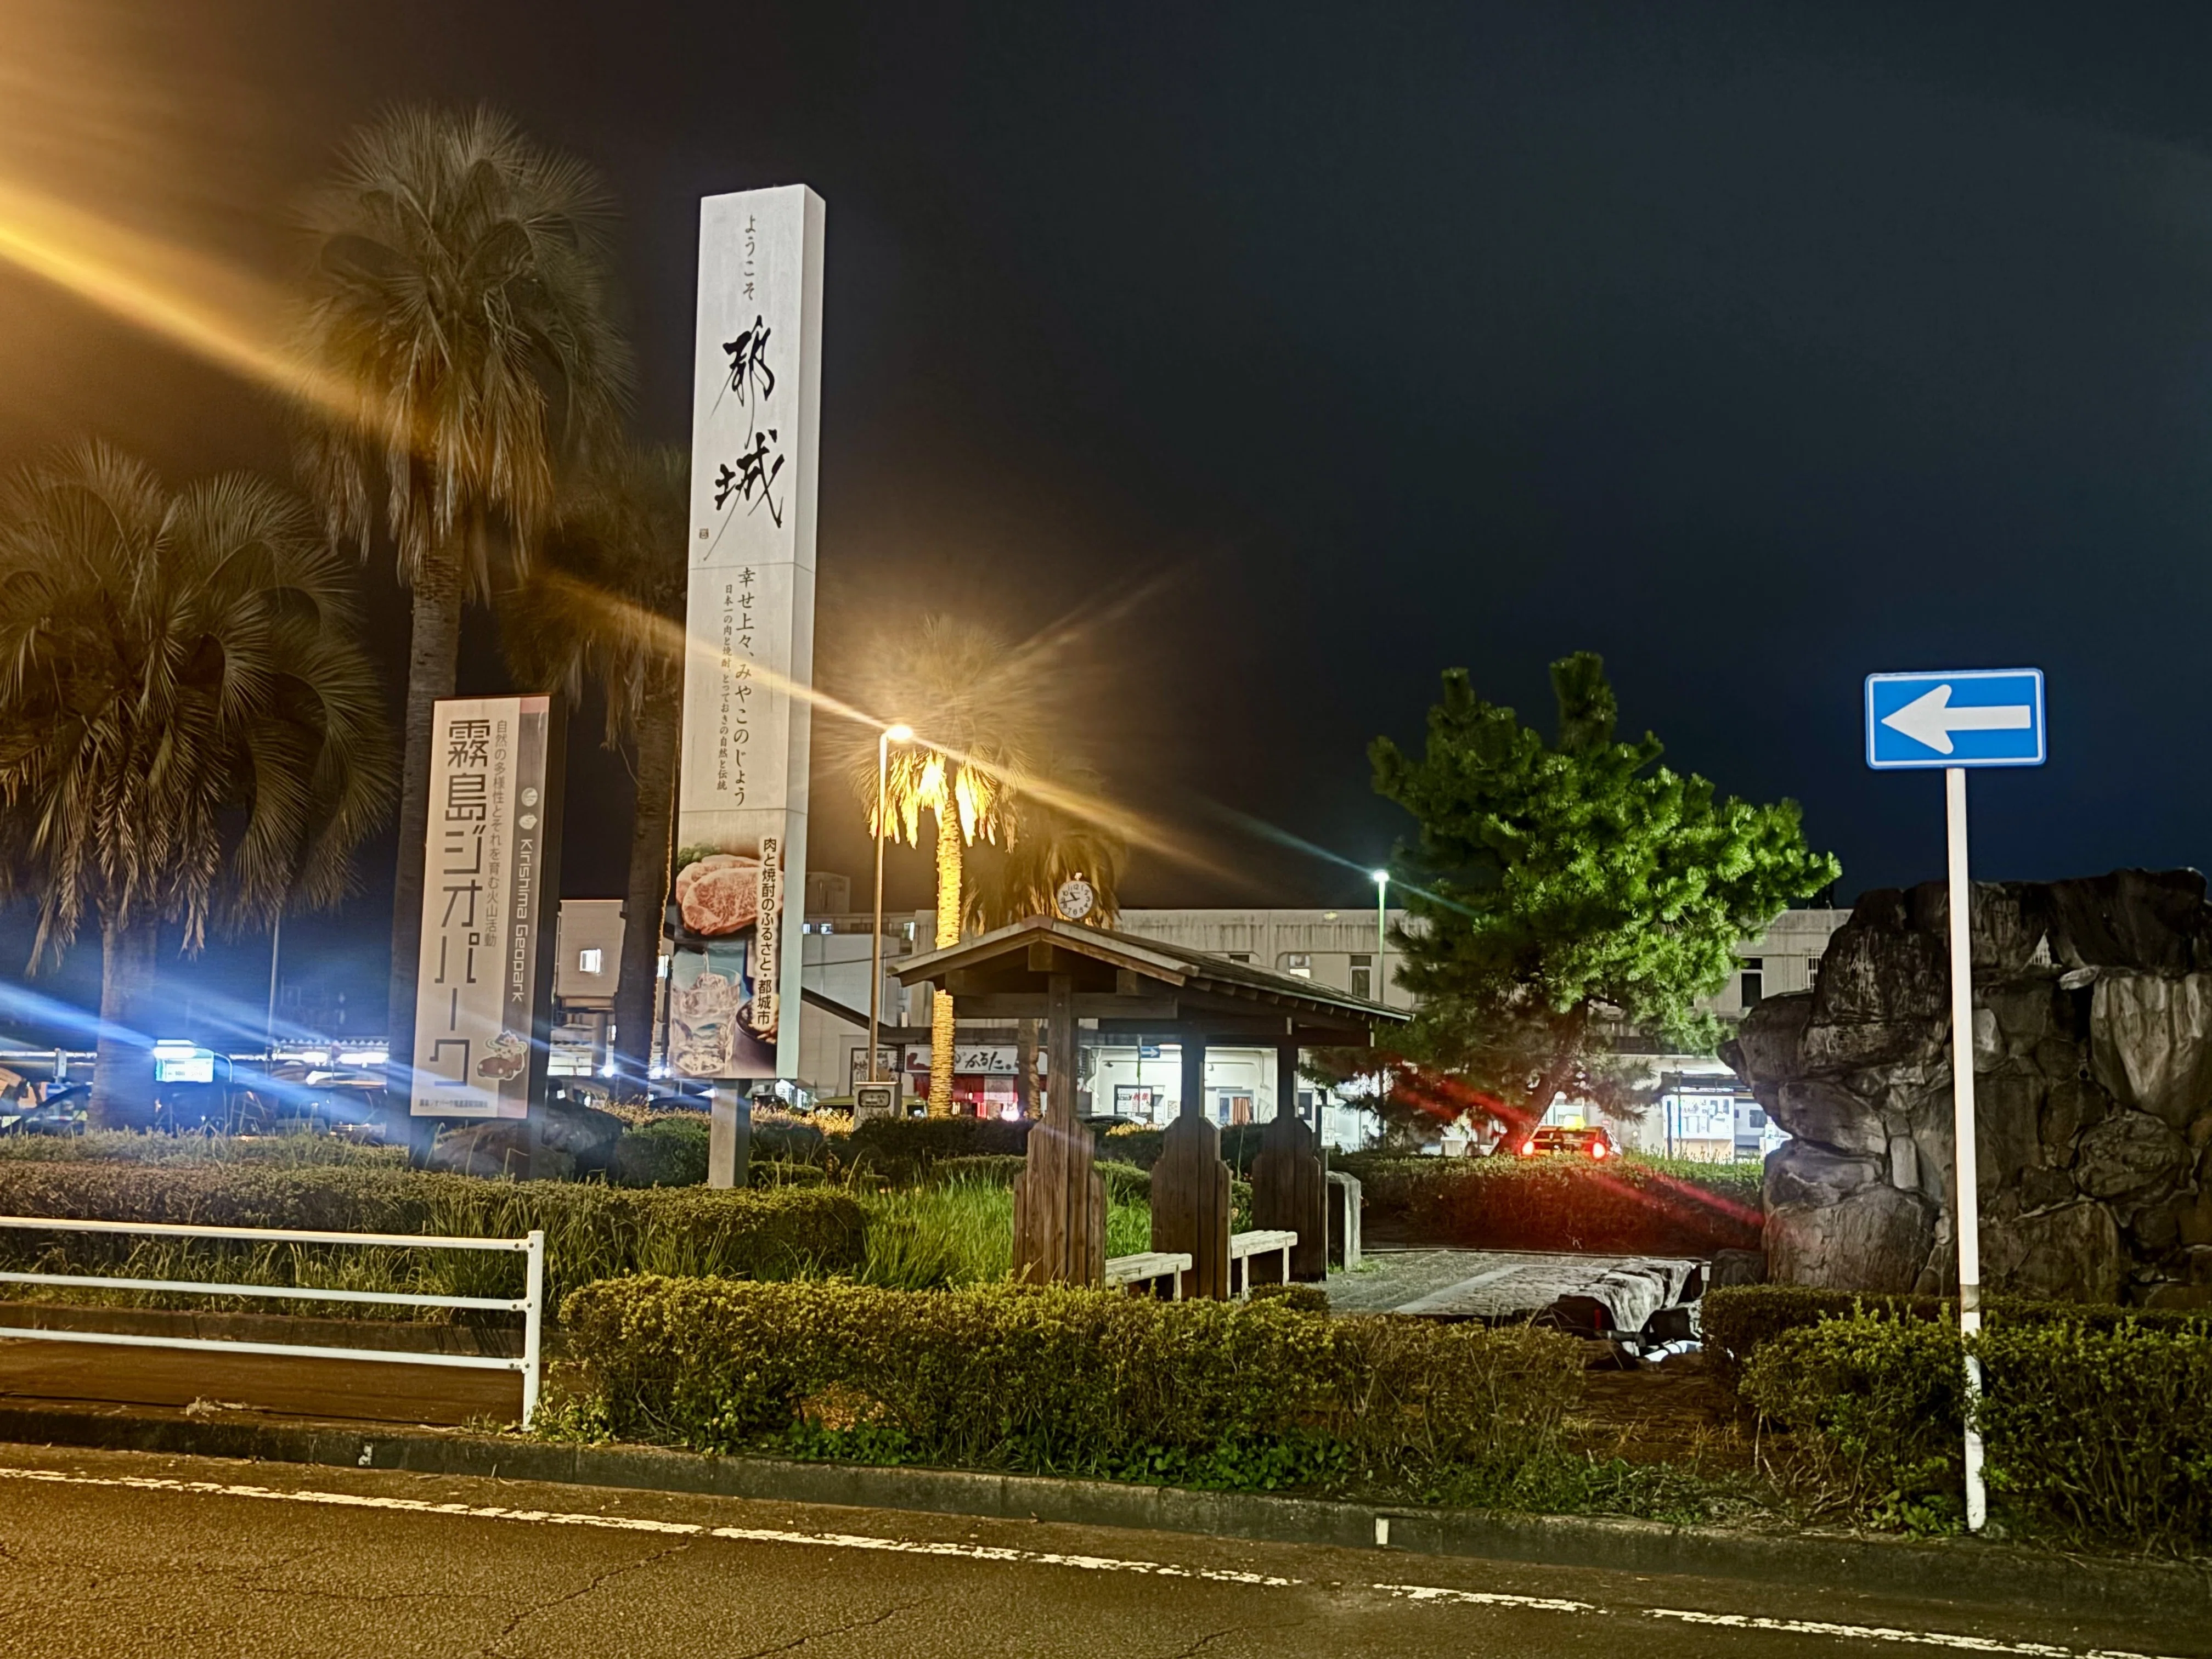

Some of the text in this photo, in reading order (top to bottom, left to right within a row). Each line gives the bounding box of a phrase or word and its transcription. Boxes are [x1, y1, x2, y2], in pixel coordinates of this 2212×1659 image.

[742, 214, 757, 300] ようこそ
[704, 315, 785, 561] 都城
[733, 567, 756, 806] 幸せ上々、みやこのじょう
[430, 719, 490, 1086] 霧島ジオパーク
[484, 719, 507, 947] 自然の多様性とそれを育む火山活動
[511, 839, 533, 1002] Kirishima Geopark
[757, 837, 777, 1025] 肉と焼酎のふるさと・都城市
